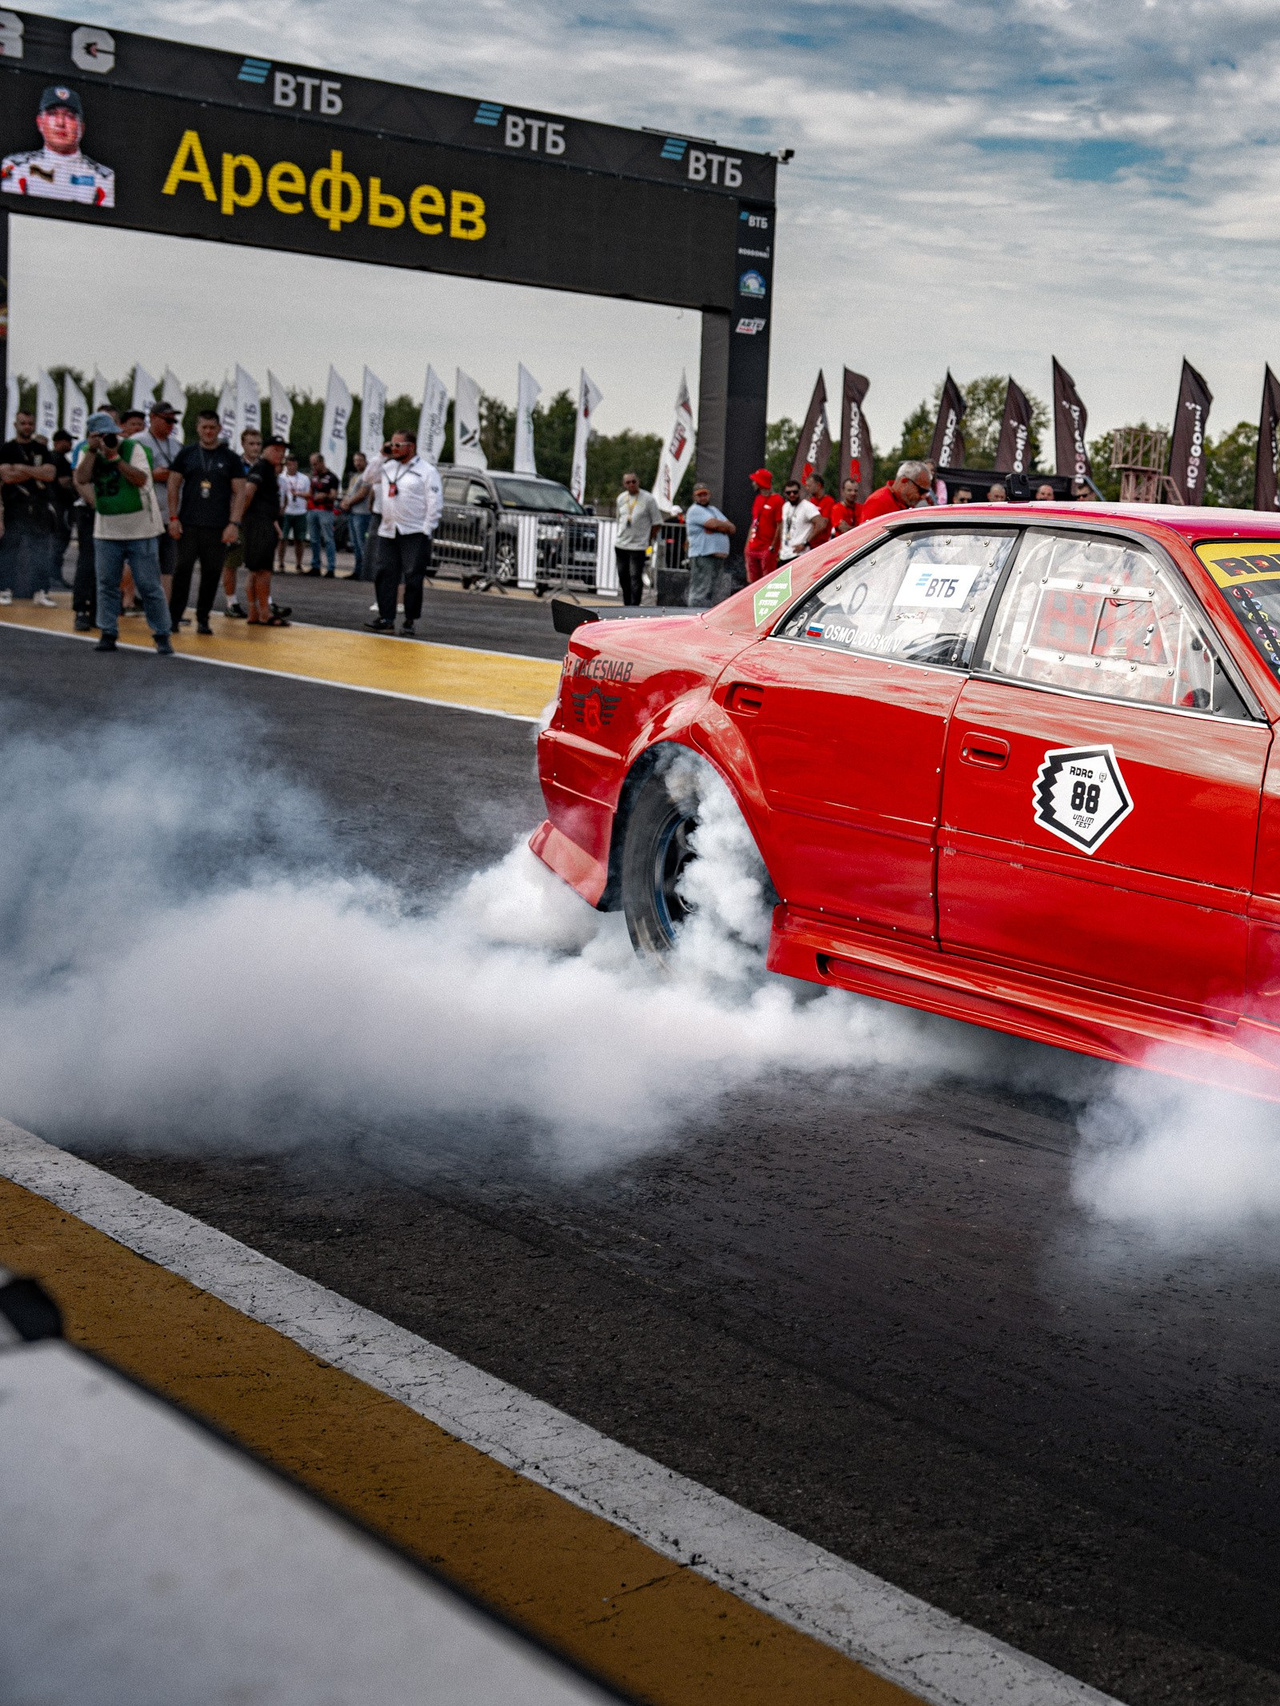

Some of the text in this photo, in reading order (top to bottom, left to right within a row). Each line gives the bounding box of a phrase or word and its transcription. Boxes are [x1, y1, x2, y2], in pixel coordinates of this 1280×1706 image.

[273, 71, 343, 115] ВТБ
[504, 114, 566, 155] ВТБ
[688, 149, 743, 188] ВТБ
[161, 129, 487, 241] Арефьев
[748, 215, 768, 229] ВТБ
[273, 411, 289, 437] ТБ
[925, 578, 960, 598] ВТБ
[573, 658, 634, 682] RACESNAB
[1069, 766, 1094, 779] RDRC
[1070, 780, 1101, 814] 88
[1075, 820, 1091, 829] FEST
